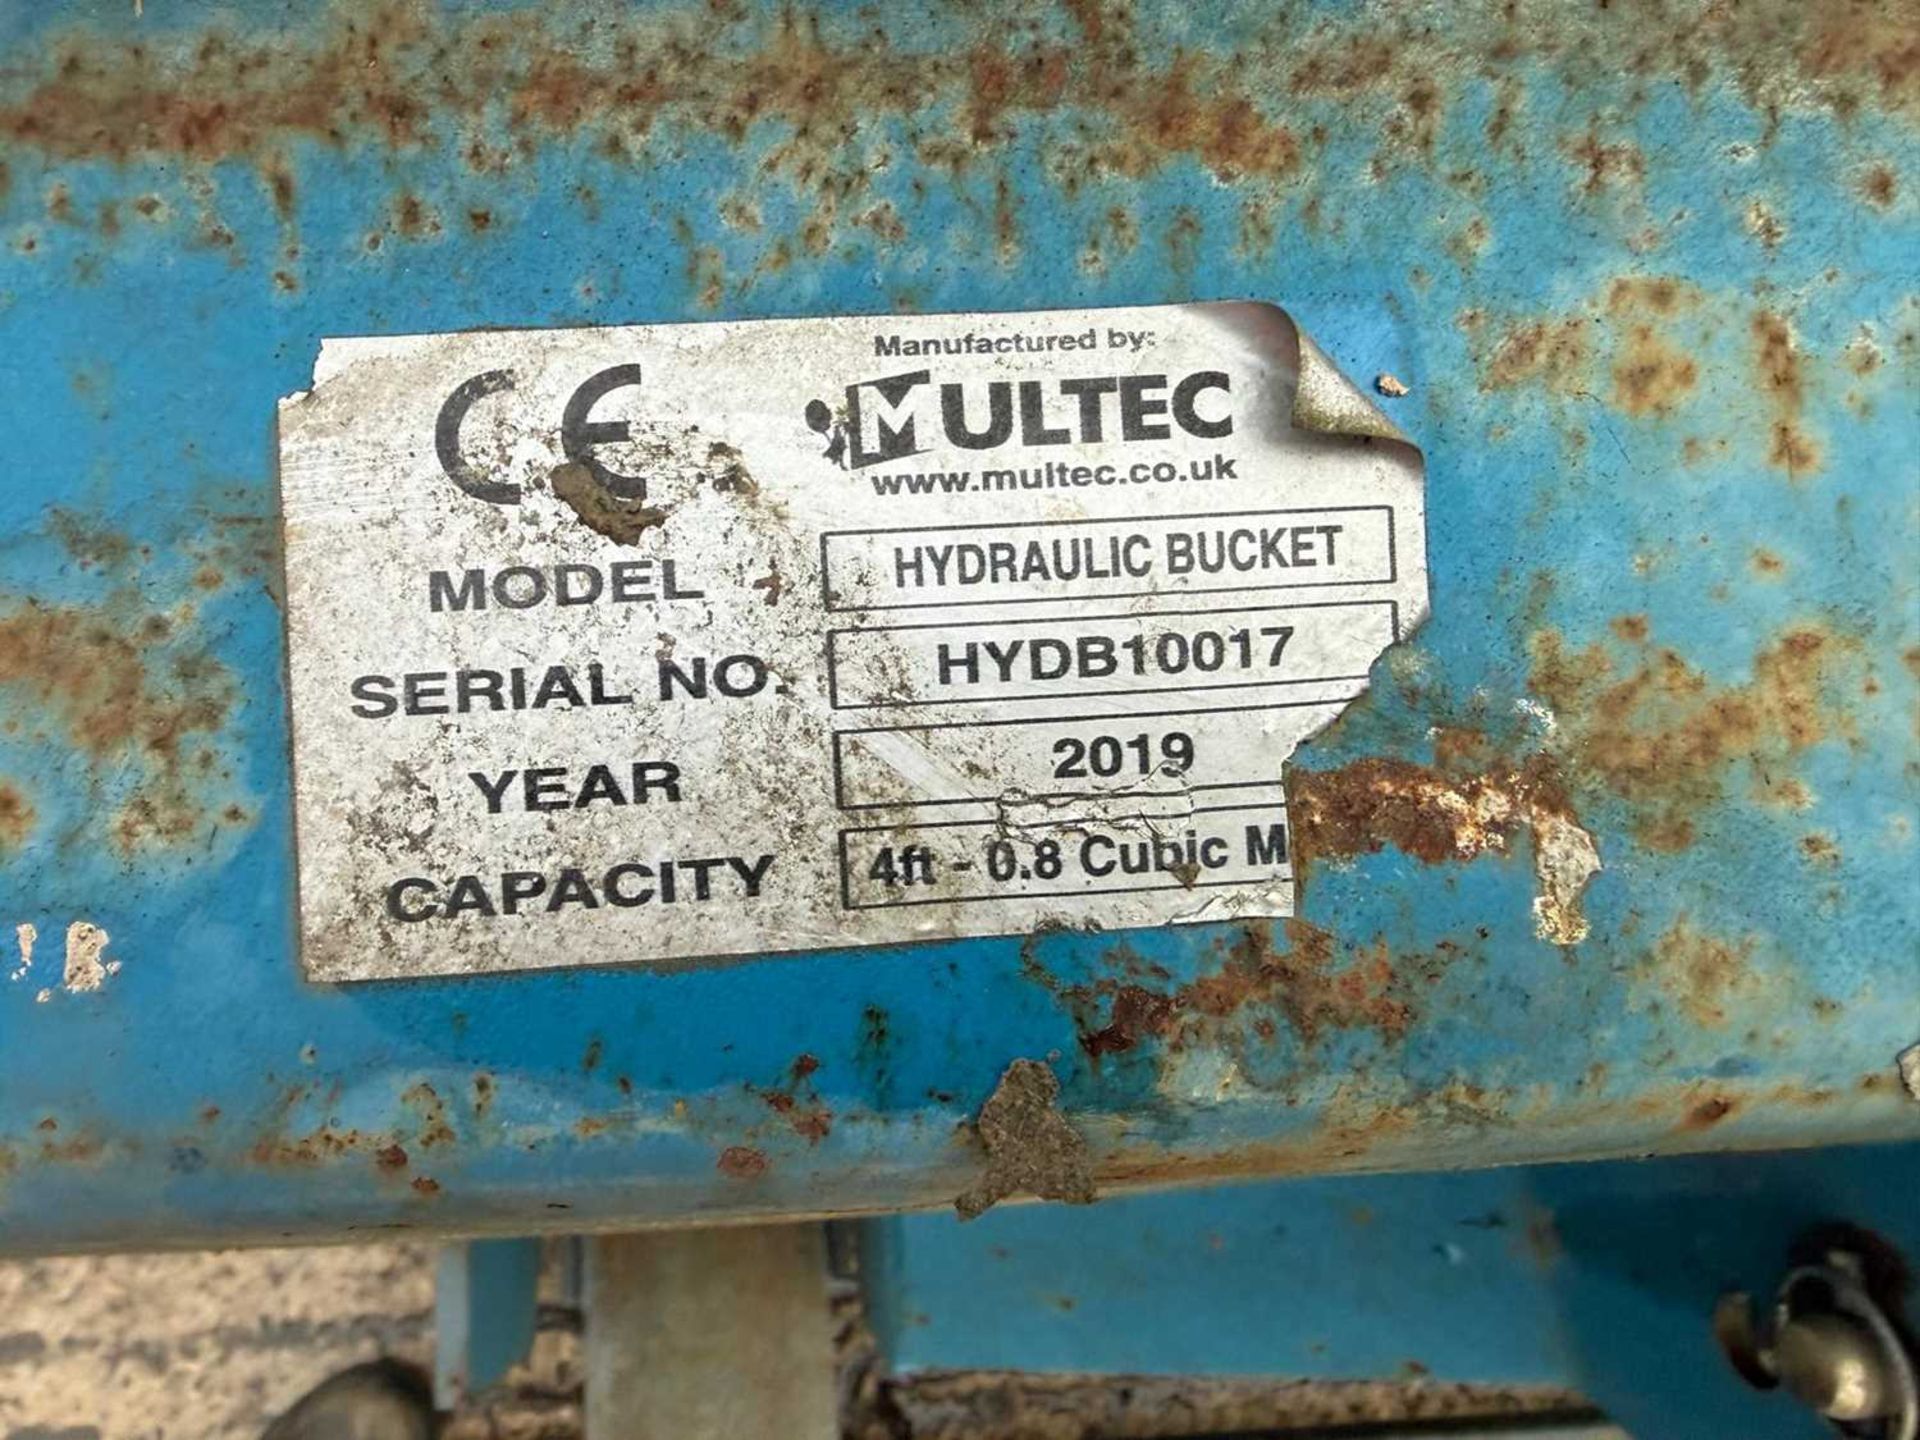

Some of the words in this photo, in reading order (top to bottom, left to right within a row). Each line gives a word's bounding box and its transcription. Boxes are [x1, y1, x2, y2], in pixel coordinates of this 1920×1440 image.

[874, 329, 1097, 358] Manufactured
[1108, 328, 1155, 354] by:
[846, 369, 1234, 469] MULTEC
[872, 455, 1238, 496] www.multec.co.uk
[429, 559, 704, 612] MODEL
[894, 534, 1152, 588] HYDRAULIC
[1167, 525, 1343, 575] BUCKET
[938, 626, 1295, 685] HYDB10017
[351, 663, 633, 718] SERIAL
[658, 654, 789, 700] NO.
[1053, 732, 1195, 779] 2019
[468, 762, 683, 814] YEAR
[869, 845, 935, 885] 4ft
[988, 839, 1062, 881] 0.8
[1080, 833, 1228, 876] Cubic
[1245, 823, 1287, 865] M
[386, 855, 775, 924] CAPACITY
